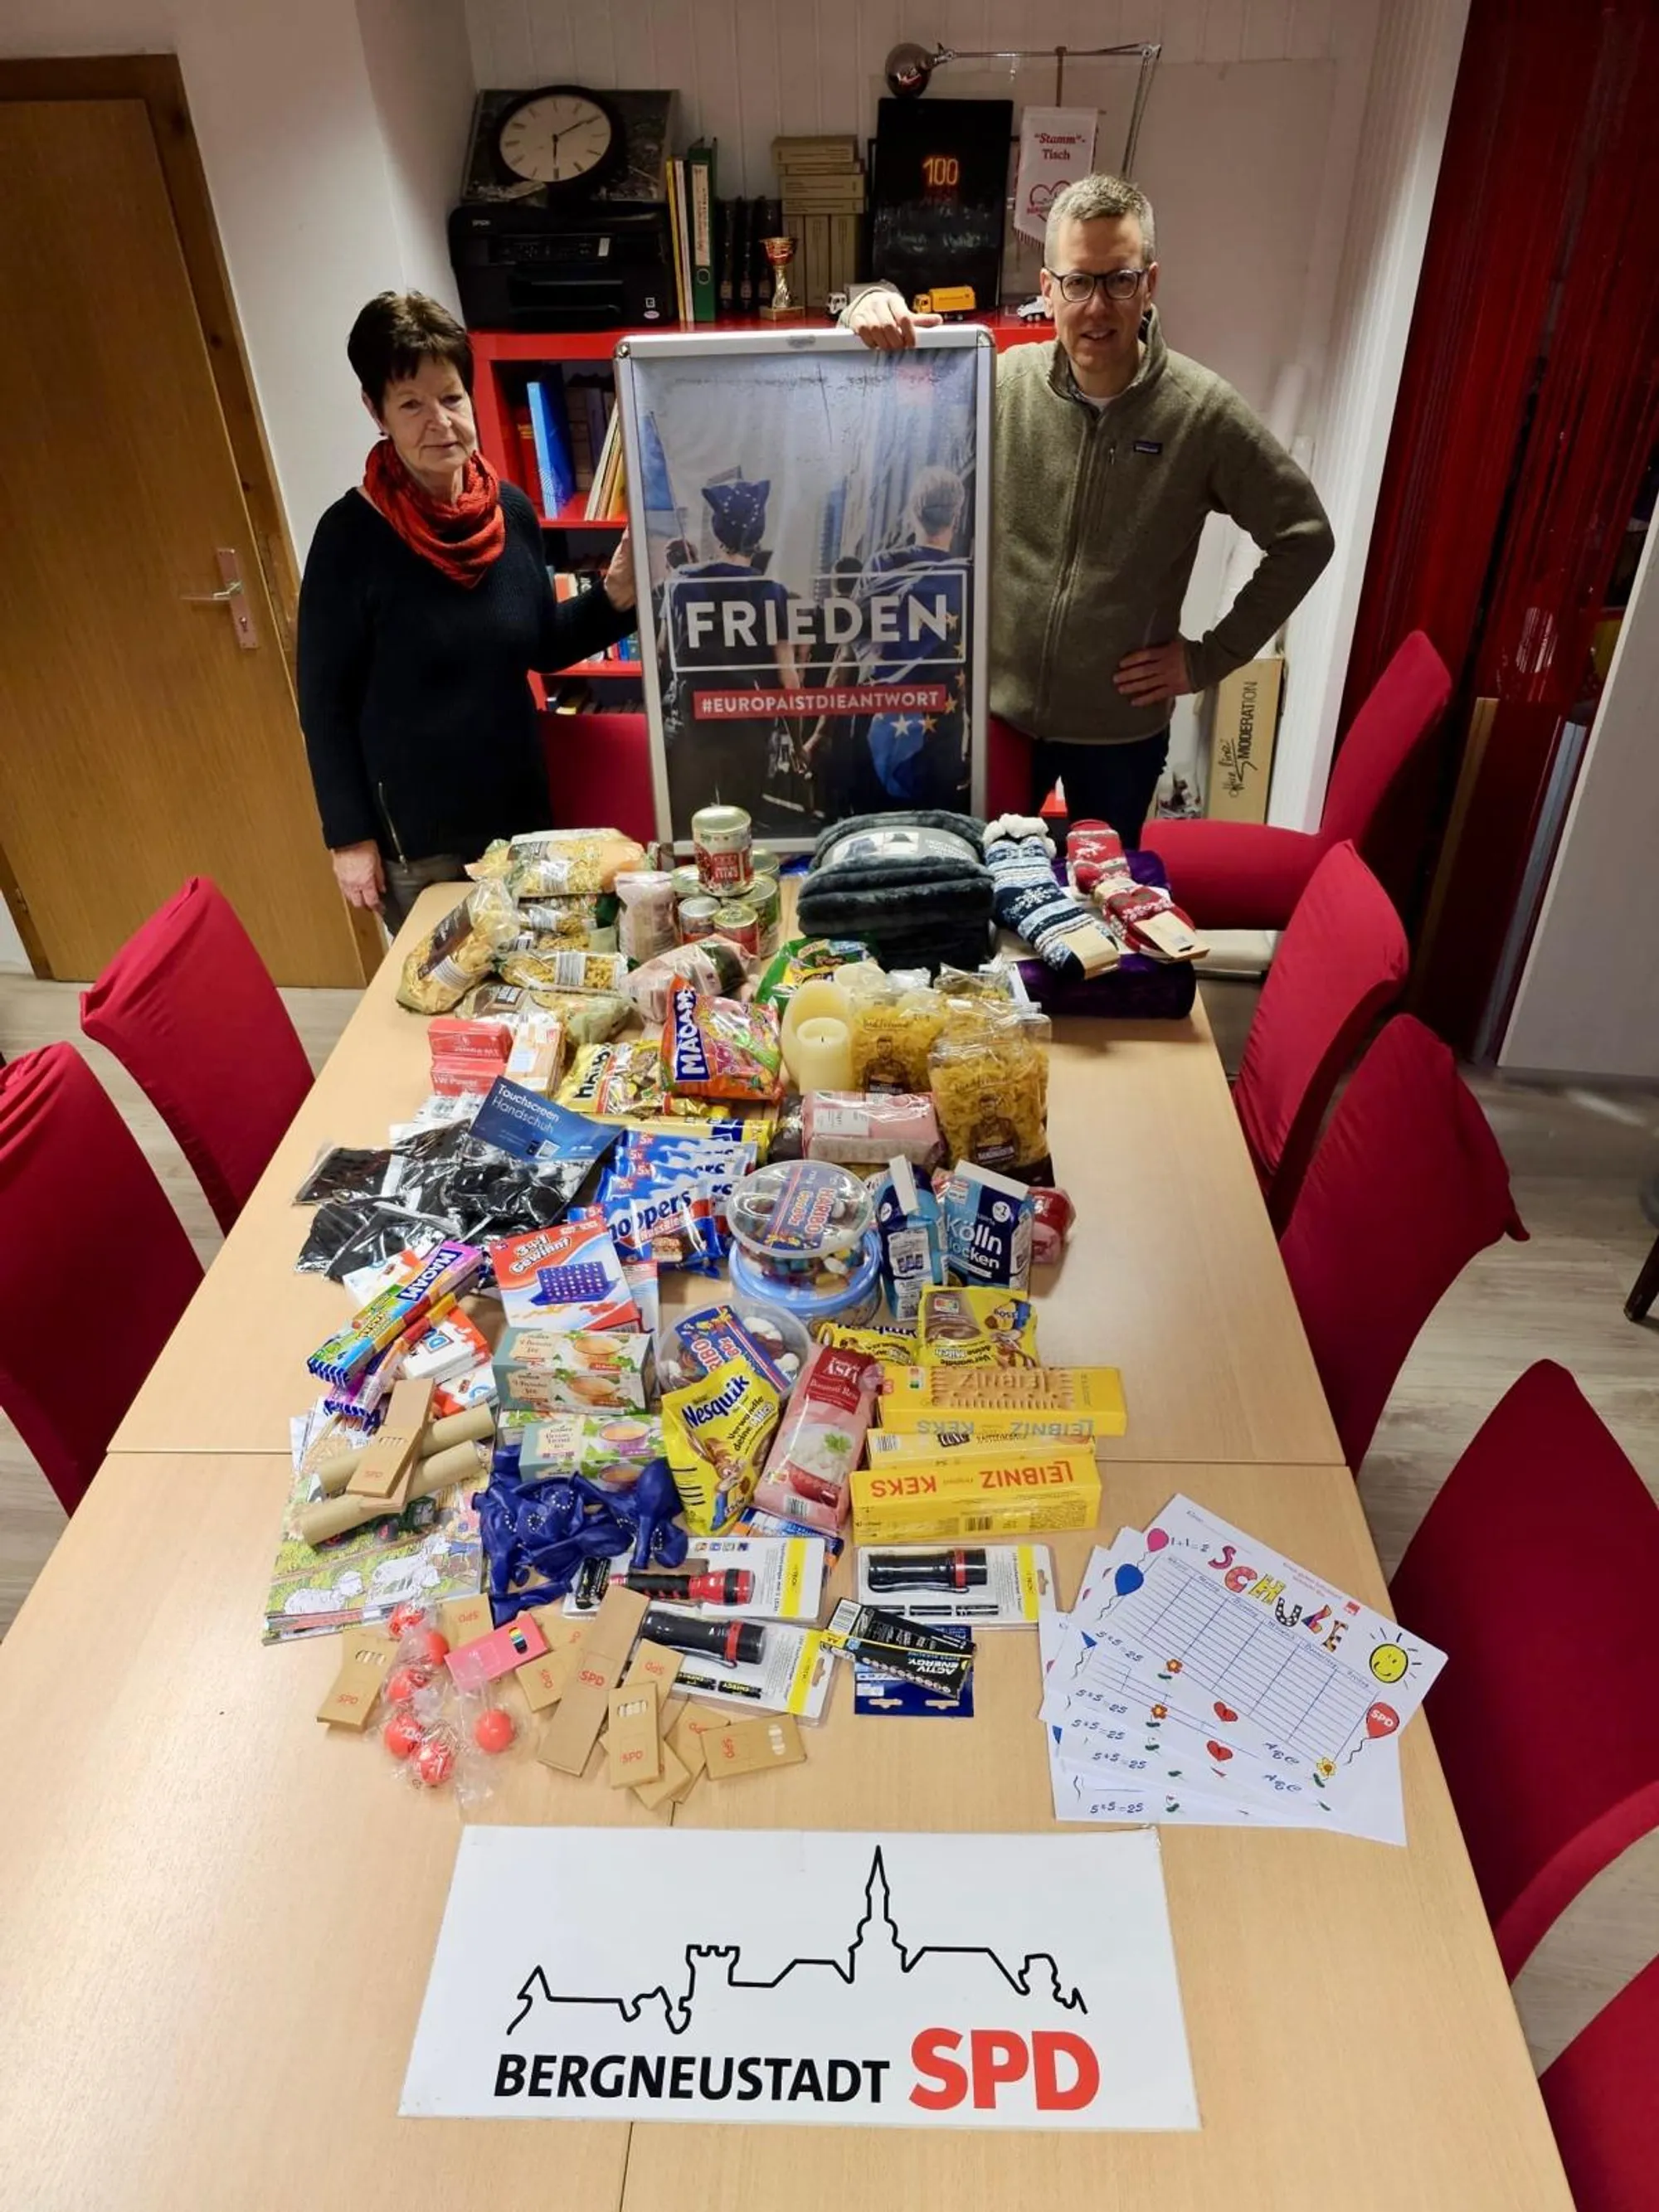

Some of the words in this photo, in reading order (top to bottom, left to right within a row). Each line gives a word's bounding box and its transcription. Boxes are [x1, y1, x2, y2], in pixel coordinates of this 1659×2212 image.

[1042, 148, 1071, 161] Tisch
[922, 157, 959, 186] 100
[684, 593, 949, 649] FRIEDEN
[701, 690, 940, 714] #EUROPAISTDIEANTWORT
[1237, 680, 1258, 761] MODERATION
[491, 1096, 554, 1135] Handschuh
[498, 1083, 561, 1123] Touchscreen
[946, 1214, 1003, 1256] Kölln
[398, 1249, 463, 1302] MAOAM
[690, 1334, 725, 1373] RIBO
[681, 1375, 750, 1430] Nesquik
[917, 1417, 975, 1437] KEKS
[1010, 1418, 1097, 1437] LEIBNIZ
[870, 1474, 937, 1499] KEKS
[979, 1459, 1075, 1490] LEIBNIZ
[1208, 1544, 1349, 1654] SCHULE
[907, 1658, 960, 1668] ENERGY
[916, 1664, 957, 1675] ACTIV
[579, 1670, 606, 1688] SPD
[1370, 1709, 1395, 1728] SPD
[620, 1749, 644, 1764] SPD
[494, 2052, 891, 2105] BERGNEUSTADT
[908, 2026, 1101, 2112] SPD
